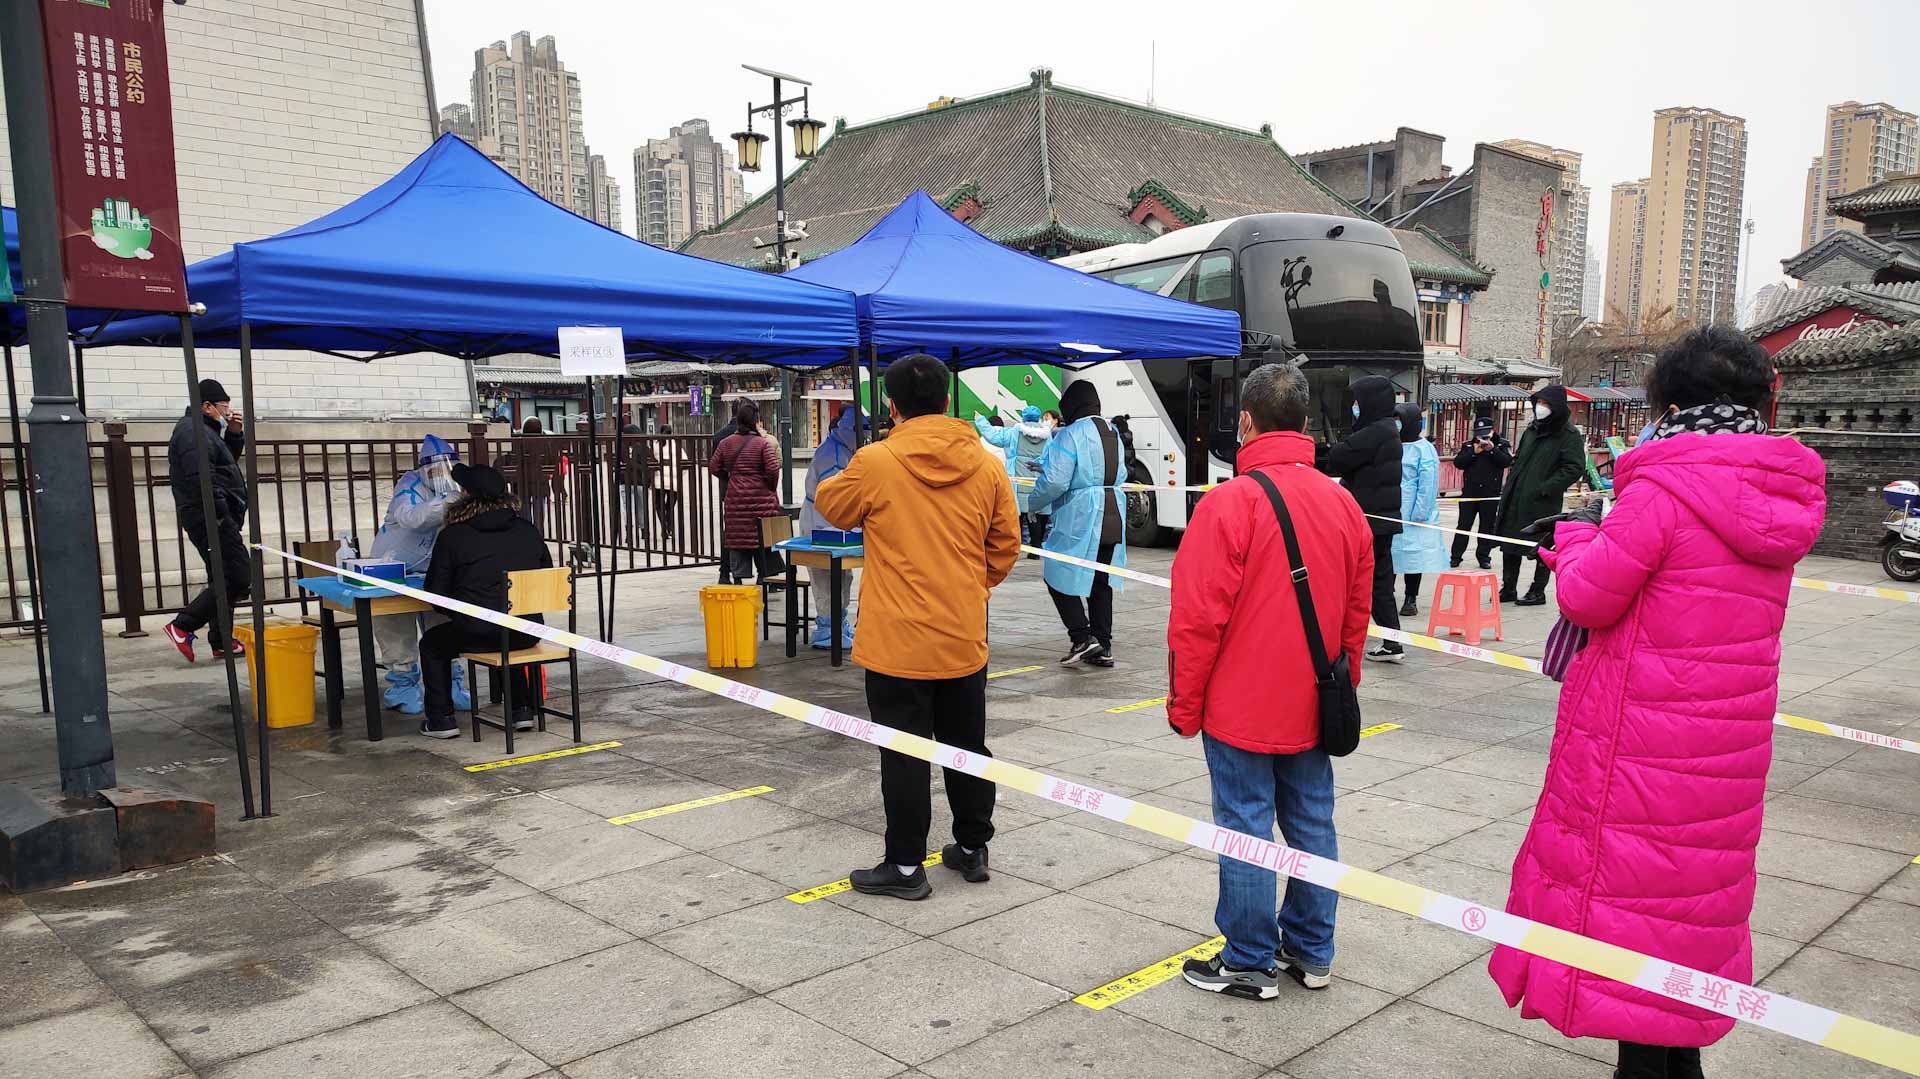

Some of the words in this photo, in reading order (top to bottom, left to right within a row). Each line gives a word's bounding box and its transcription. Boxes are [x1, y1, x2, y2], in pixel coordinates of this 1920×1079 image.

[76, 69, 90, 103] 文明出行
[122, 41, 145, 104] 市民公约
